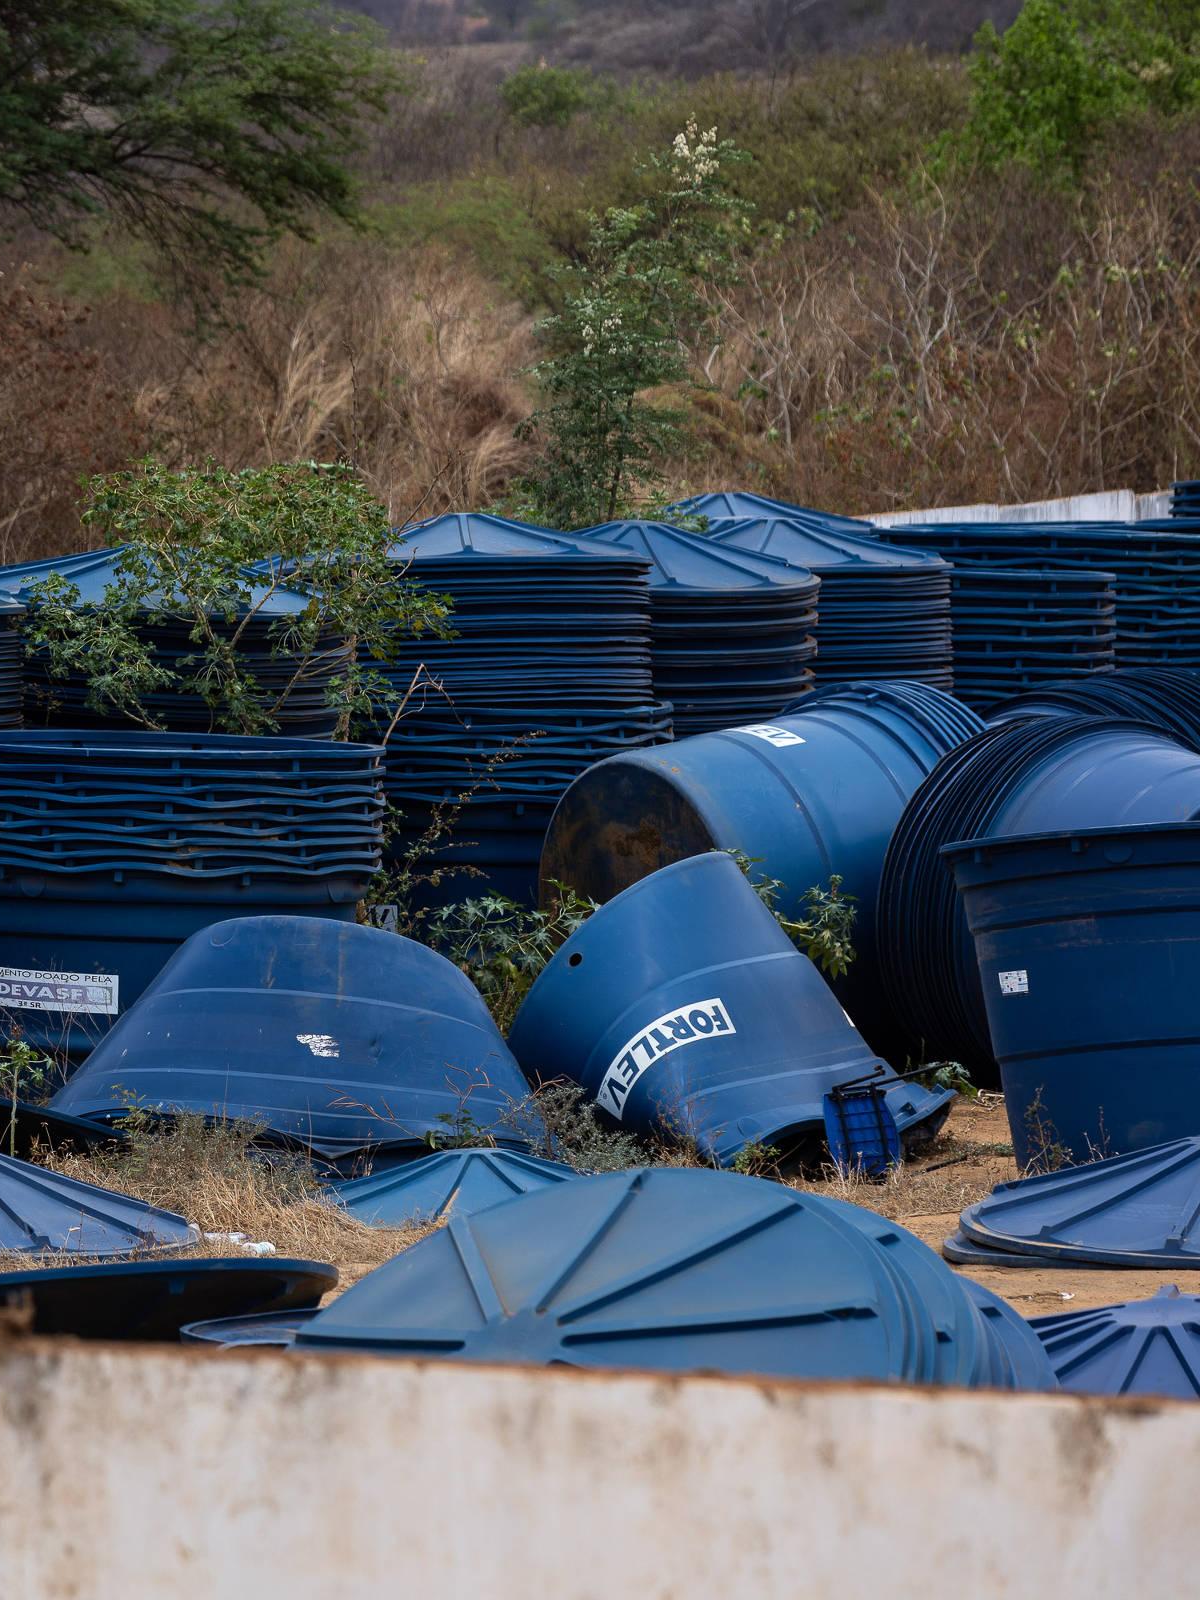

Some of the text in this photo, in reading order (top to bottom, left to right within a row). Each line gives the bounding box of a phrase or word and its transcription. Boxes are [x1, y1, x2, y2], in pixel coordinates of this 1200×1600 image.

[34, 972, 80, 982] DOADO
[84, 975, 113, 984] PELA
[30, 1001, 42, 1009] SR
[607, 1005, 730, 1111] FORTLEV
